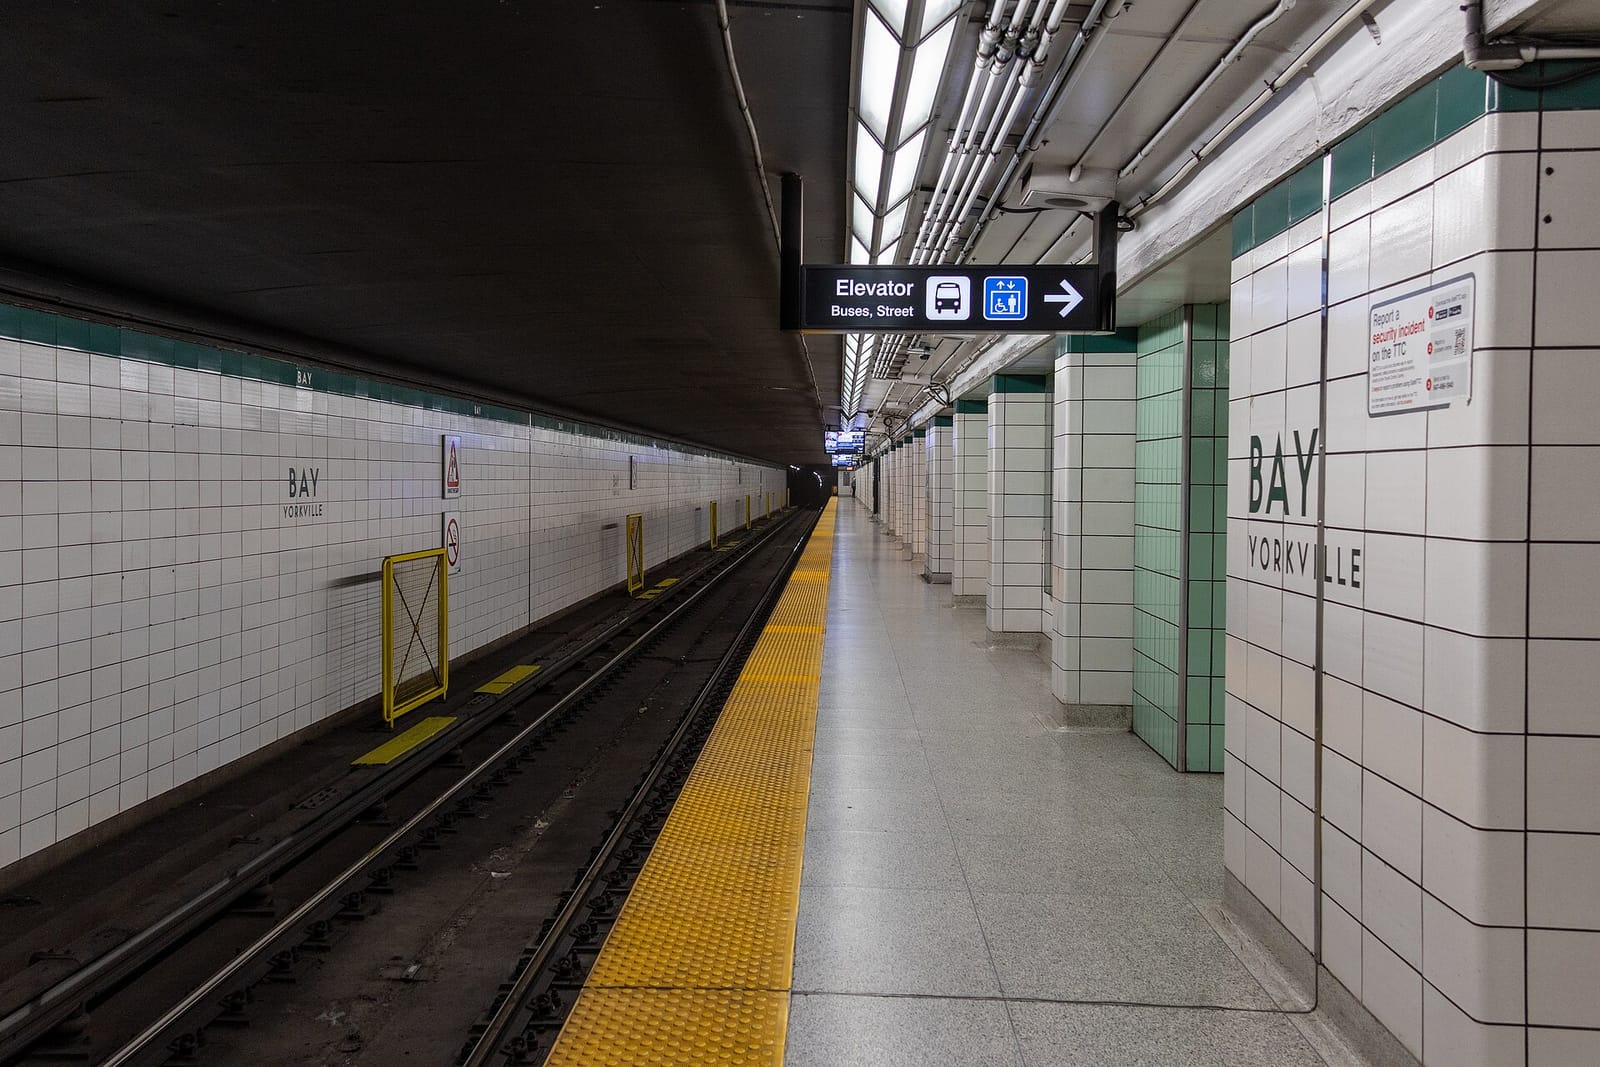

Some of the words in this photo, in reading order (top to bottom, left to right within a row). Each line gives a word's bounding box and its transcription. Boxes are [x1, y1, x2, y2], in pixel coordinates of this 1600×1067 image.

[836, 279, 914, 296] Elevator
[831, 305, 873, 318] Buses,
[876, 305, 914, 317] Street
[1373, 309, 1394, 328] Report
[1395, 310, 1400, 321] a
[1372, 327, 1397, 345] security
[1398, 318, 1425, 338] incident
[1372, 351, 1381, 362] on
[1381, 346, 1392, 360] the
[1393, 341, 1407, 358] TTC
[297, 370, 312, 385] BAY
[289, 467, 319, 498] BAY
[1249, 428, 1319, 517] BAY
[283, 504, 323, 519] YORKVILLE
[1249, 535, 1361, 588] YORKVILLE
